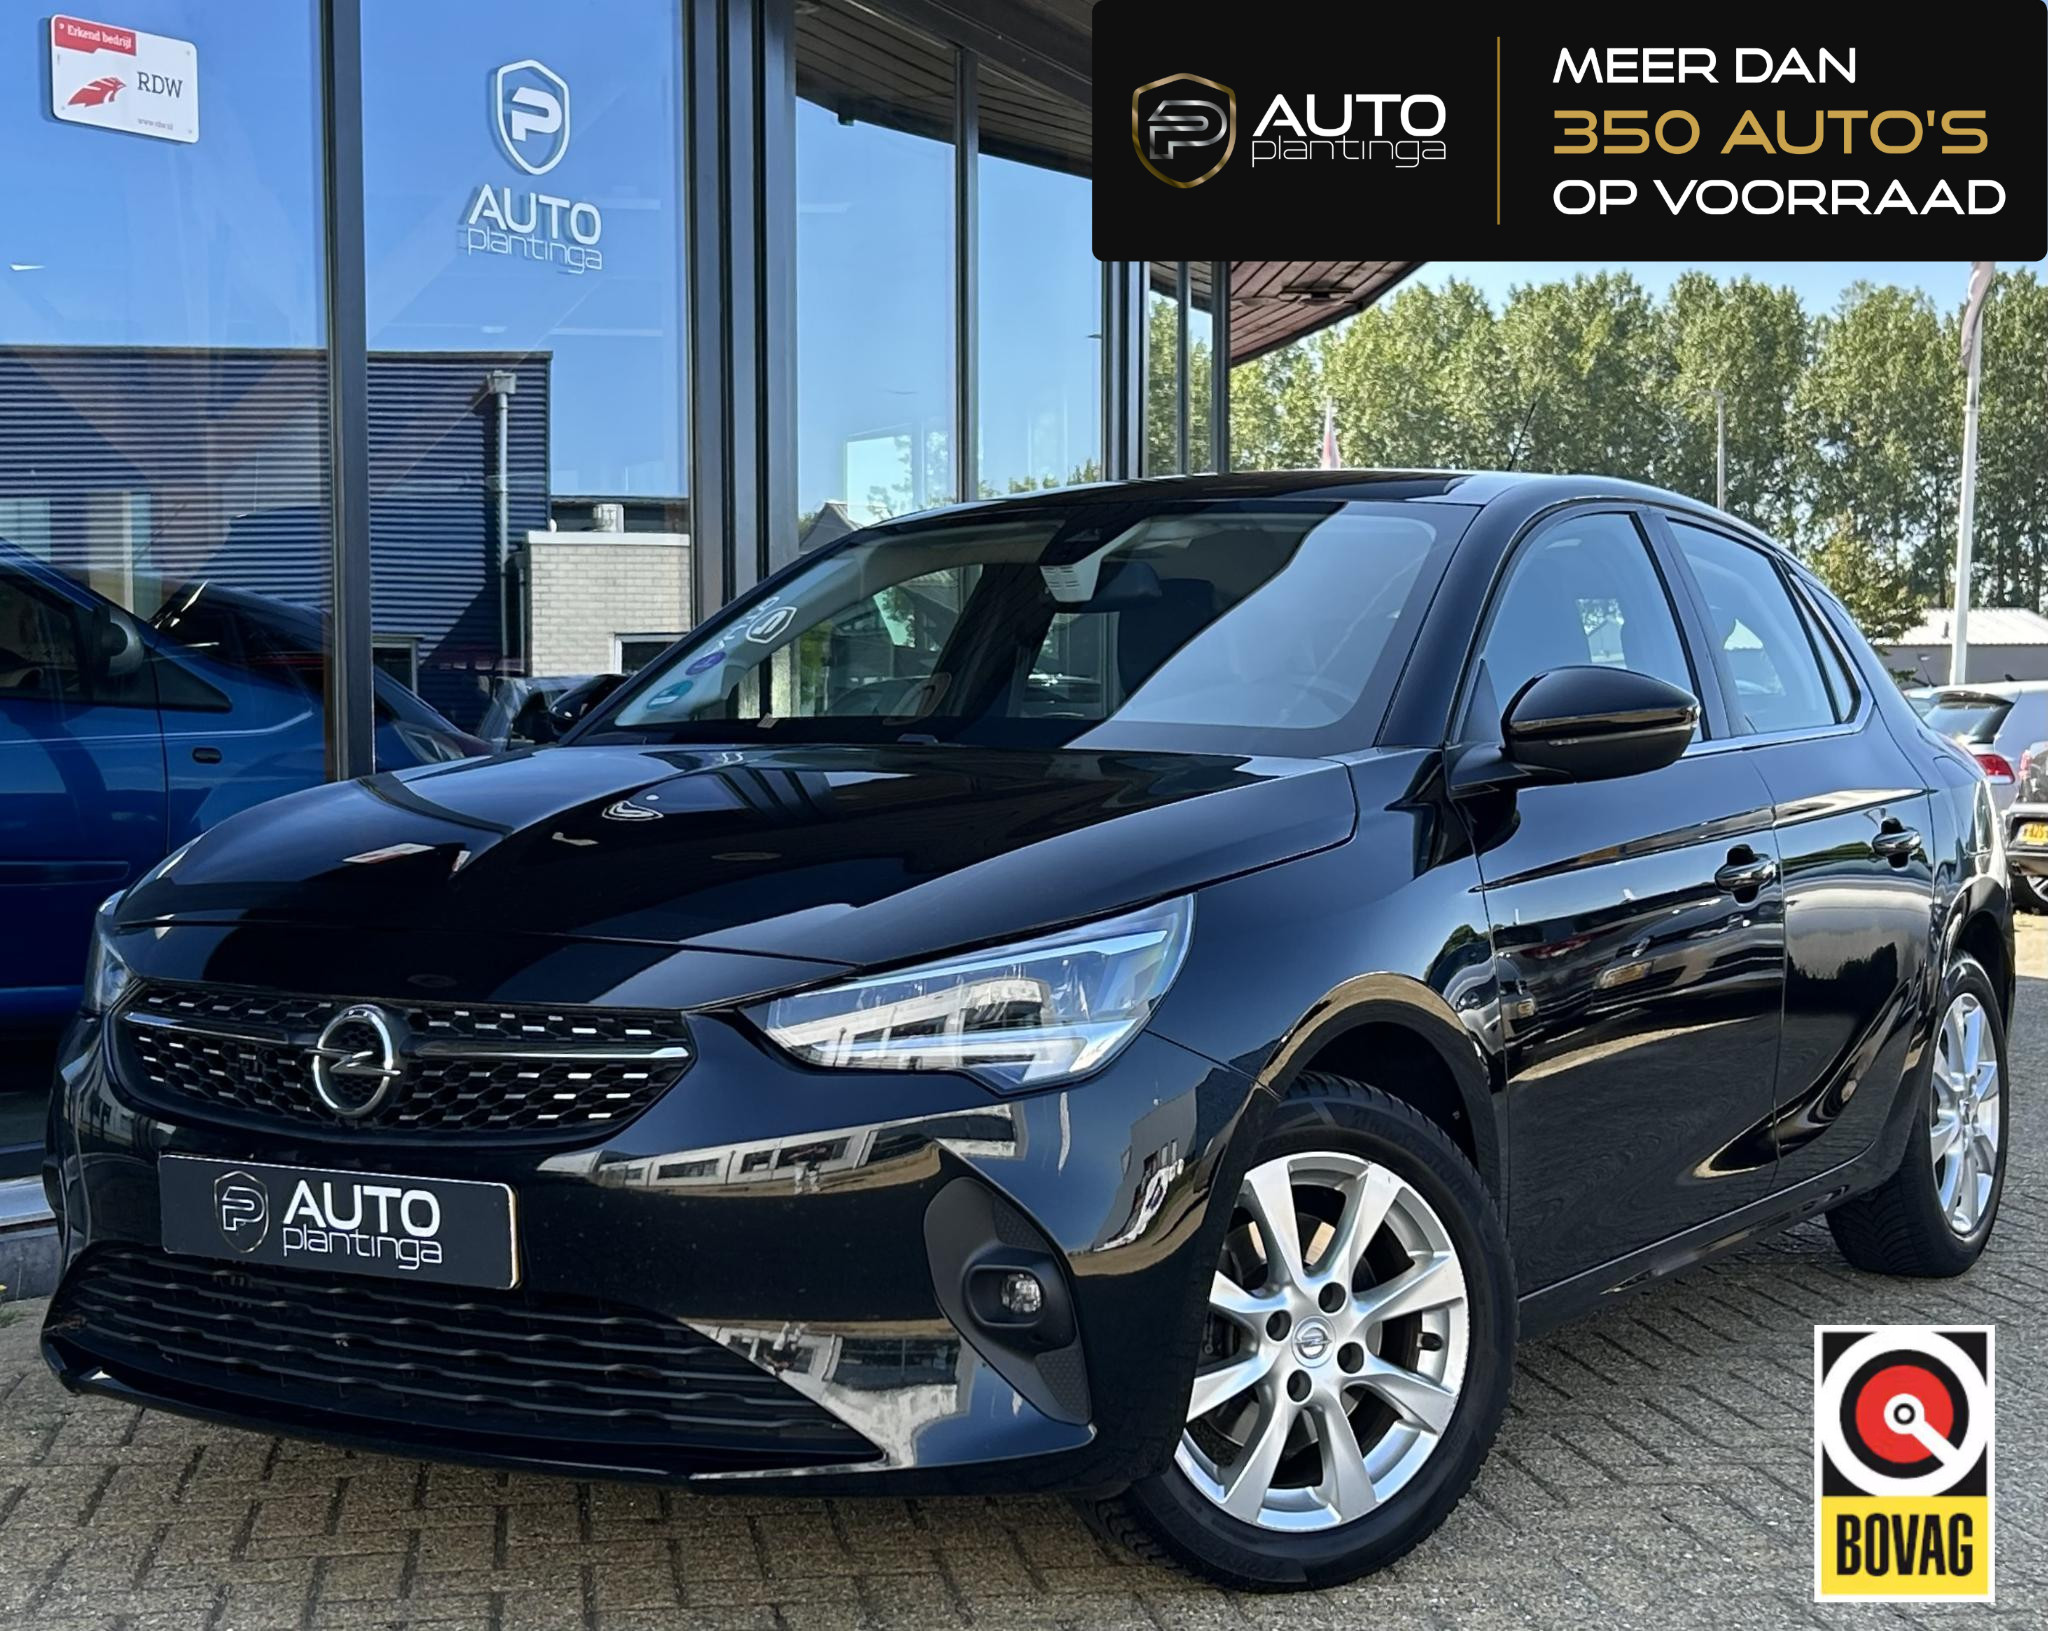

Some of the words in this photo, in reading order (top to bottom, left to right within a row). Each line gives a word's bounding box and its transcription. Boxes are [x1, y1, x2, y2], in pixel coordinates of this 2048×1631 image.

[67, 24, 101, 42] Erkend
[102, 31, 132, 49] bedrijf
[136, 71, 183, 99] RDW
[468, 183, 601, 246] AUTO
[467, 225, 603, 275] plantinga
[283, 1179, 441, 1237] AUTO
[283, 1224, 443, 1270] plantinga
